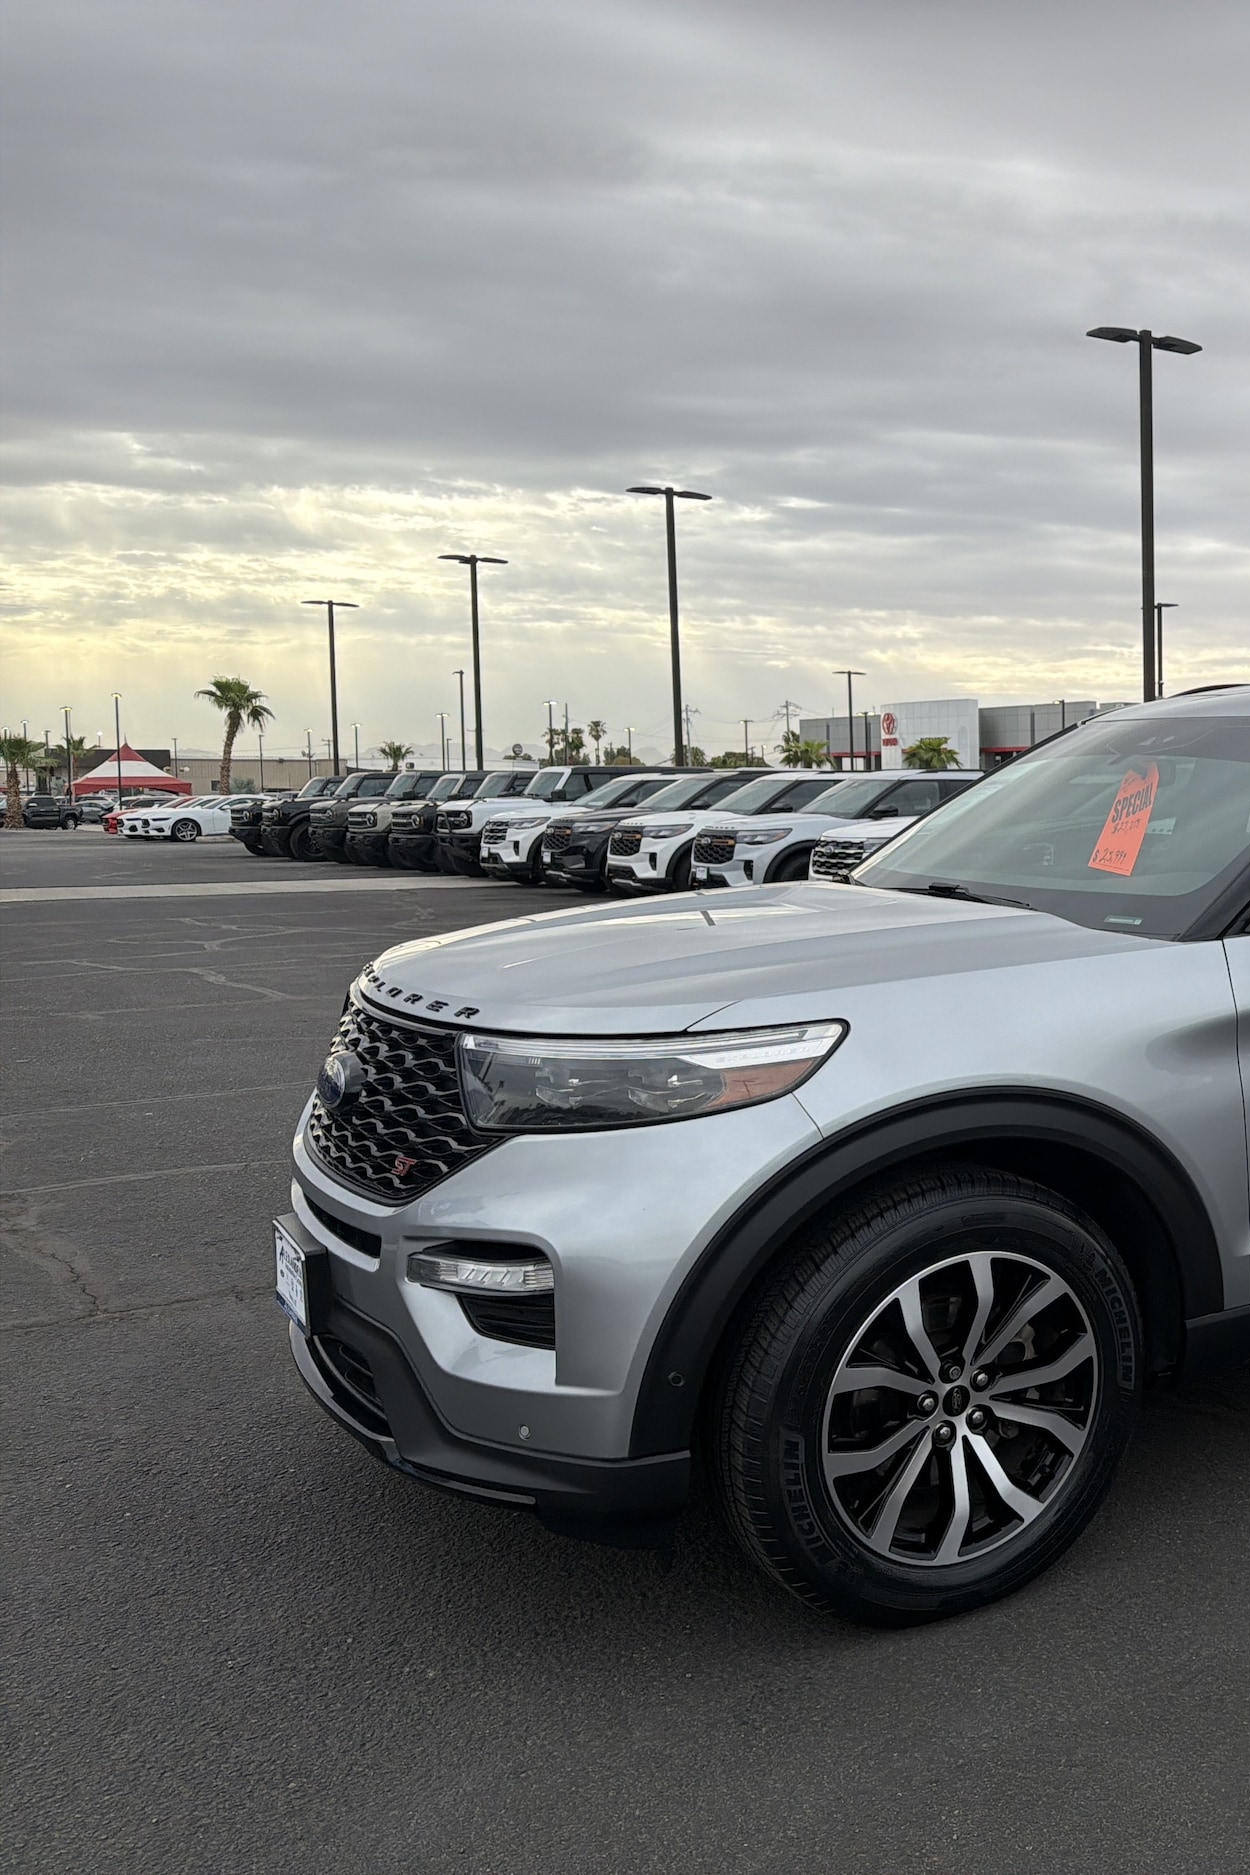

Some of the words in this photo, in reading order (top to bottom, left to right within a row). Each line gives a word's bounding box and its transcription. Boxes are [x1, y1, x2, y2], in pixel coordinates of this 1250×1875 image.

[1112, 783, 1153, 823] SPECIAL
[391, 1156, 418, 1176] ST
[1095, 1267, 1133, 1384] MICHELIN
